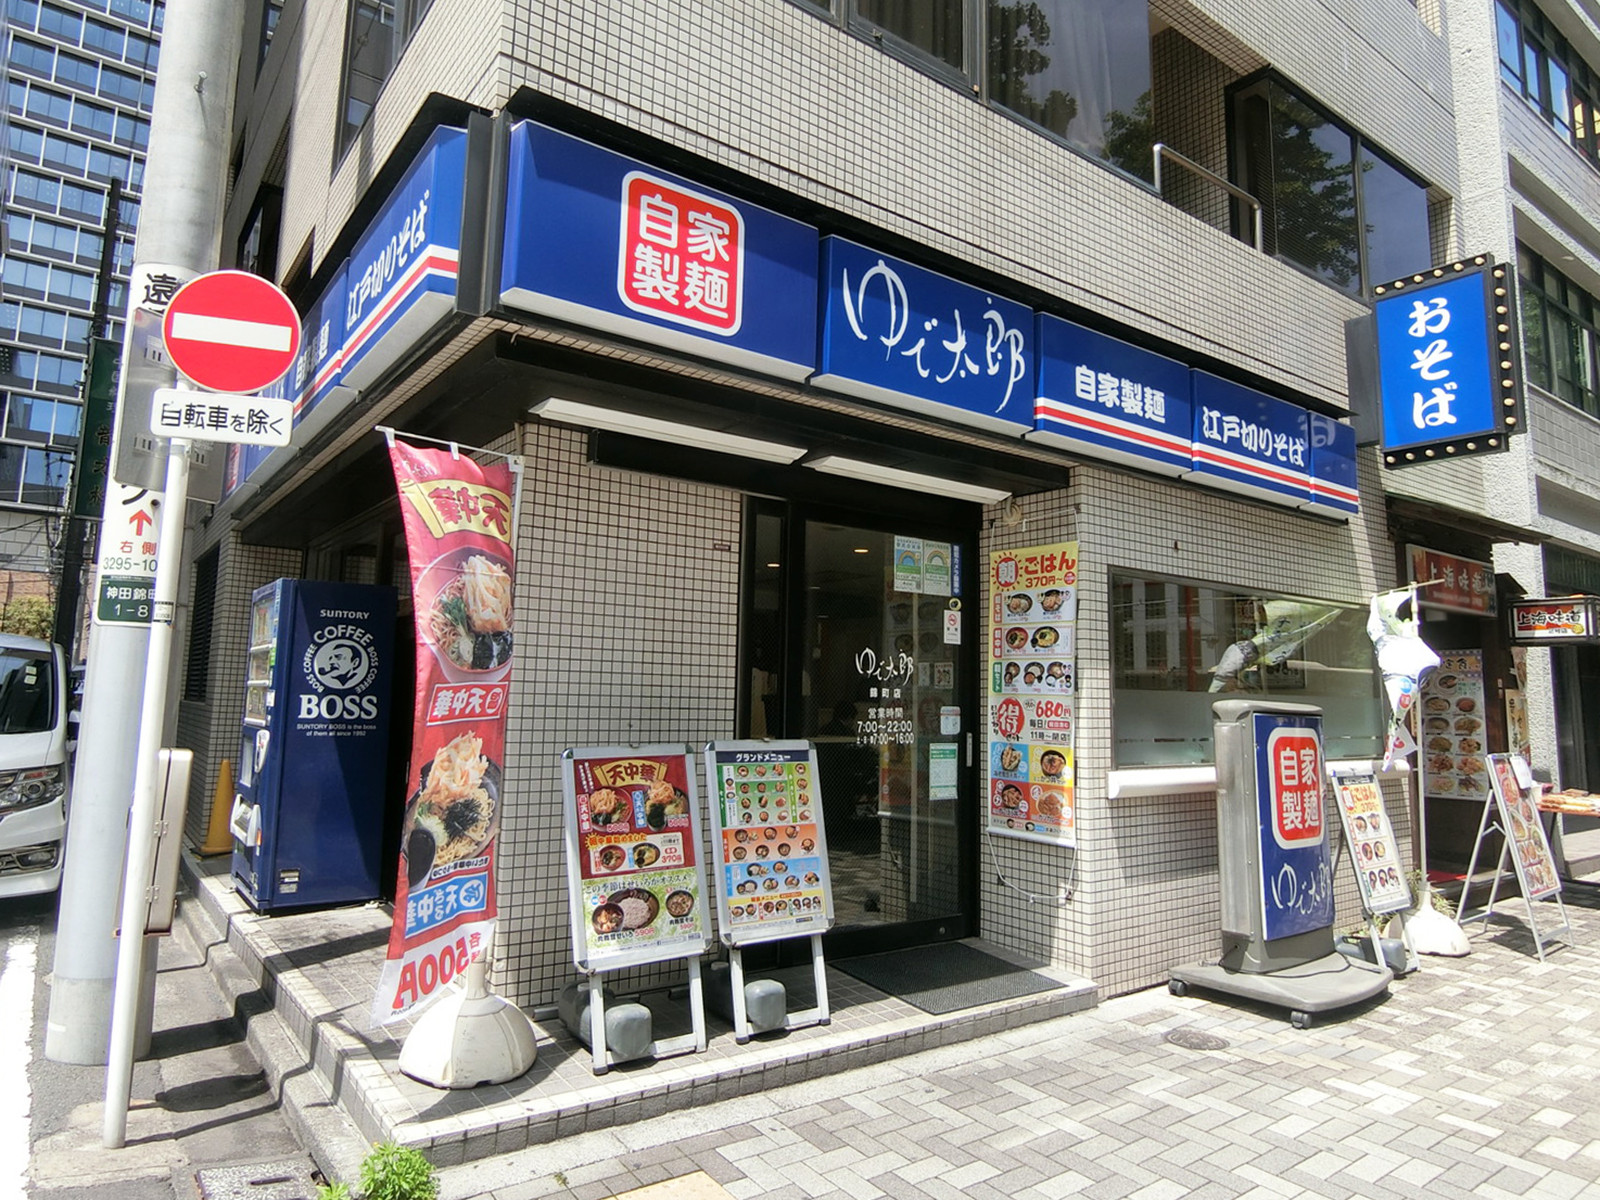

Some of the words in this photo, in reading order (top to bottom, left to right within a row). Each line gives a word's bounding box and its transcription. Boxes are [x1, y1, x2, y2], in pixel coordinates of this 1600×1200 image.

[638, 193, 731, 263] 自家
[347, 189, 430, 331] 江戸切りそば
[631, 242, 729, 320] 製麺
[842, 259, 1027, 414] ゆで太郎
[1408, 297, 1458, 429] おそば
[1075, 365, 1166, 424] 自家製麺
[161, 401, 284, 435] 自転車を除く
[1202, 405, 1305, 467] 江戸切りそば
[120, 540, 157, 556] 右側
[998, 560, 1016, 584] 朝
[1024, 551, 1077, 576] ごはん
[320, 609, 370, 620] SUNTORY
[1518, 609, 1581, 626] 上海味道
[314, 625, 373, 647] COFFEE
[303, 644, 318, 673] COFFEE
[367, 646, 379, 669] BOSS
[855, 647, 914, 686] ゆで太郎
[306, 674, 325, 693] BOSS
[355, 669, 378, 694] COFFEE
[298, 694, 378, 720] BOSS
[868, 707, 903, 719] 営業時間
[998, 703, 1019, 734] 得
[606, 761, 657, 786] 天中華
[736, 753, 790, 762] グランドメニュー
[1280, 747, 1318, 786] 自家
[1282, 790, 1320, 831] 製麺
[1271, 857, 1330, 916] ゆで太郎
